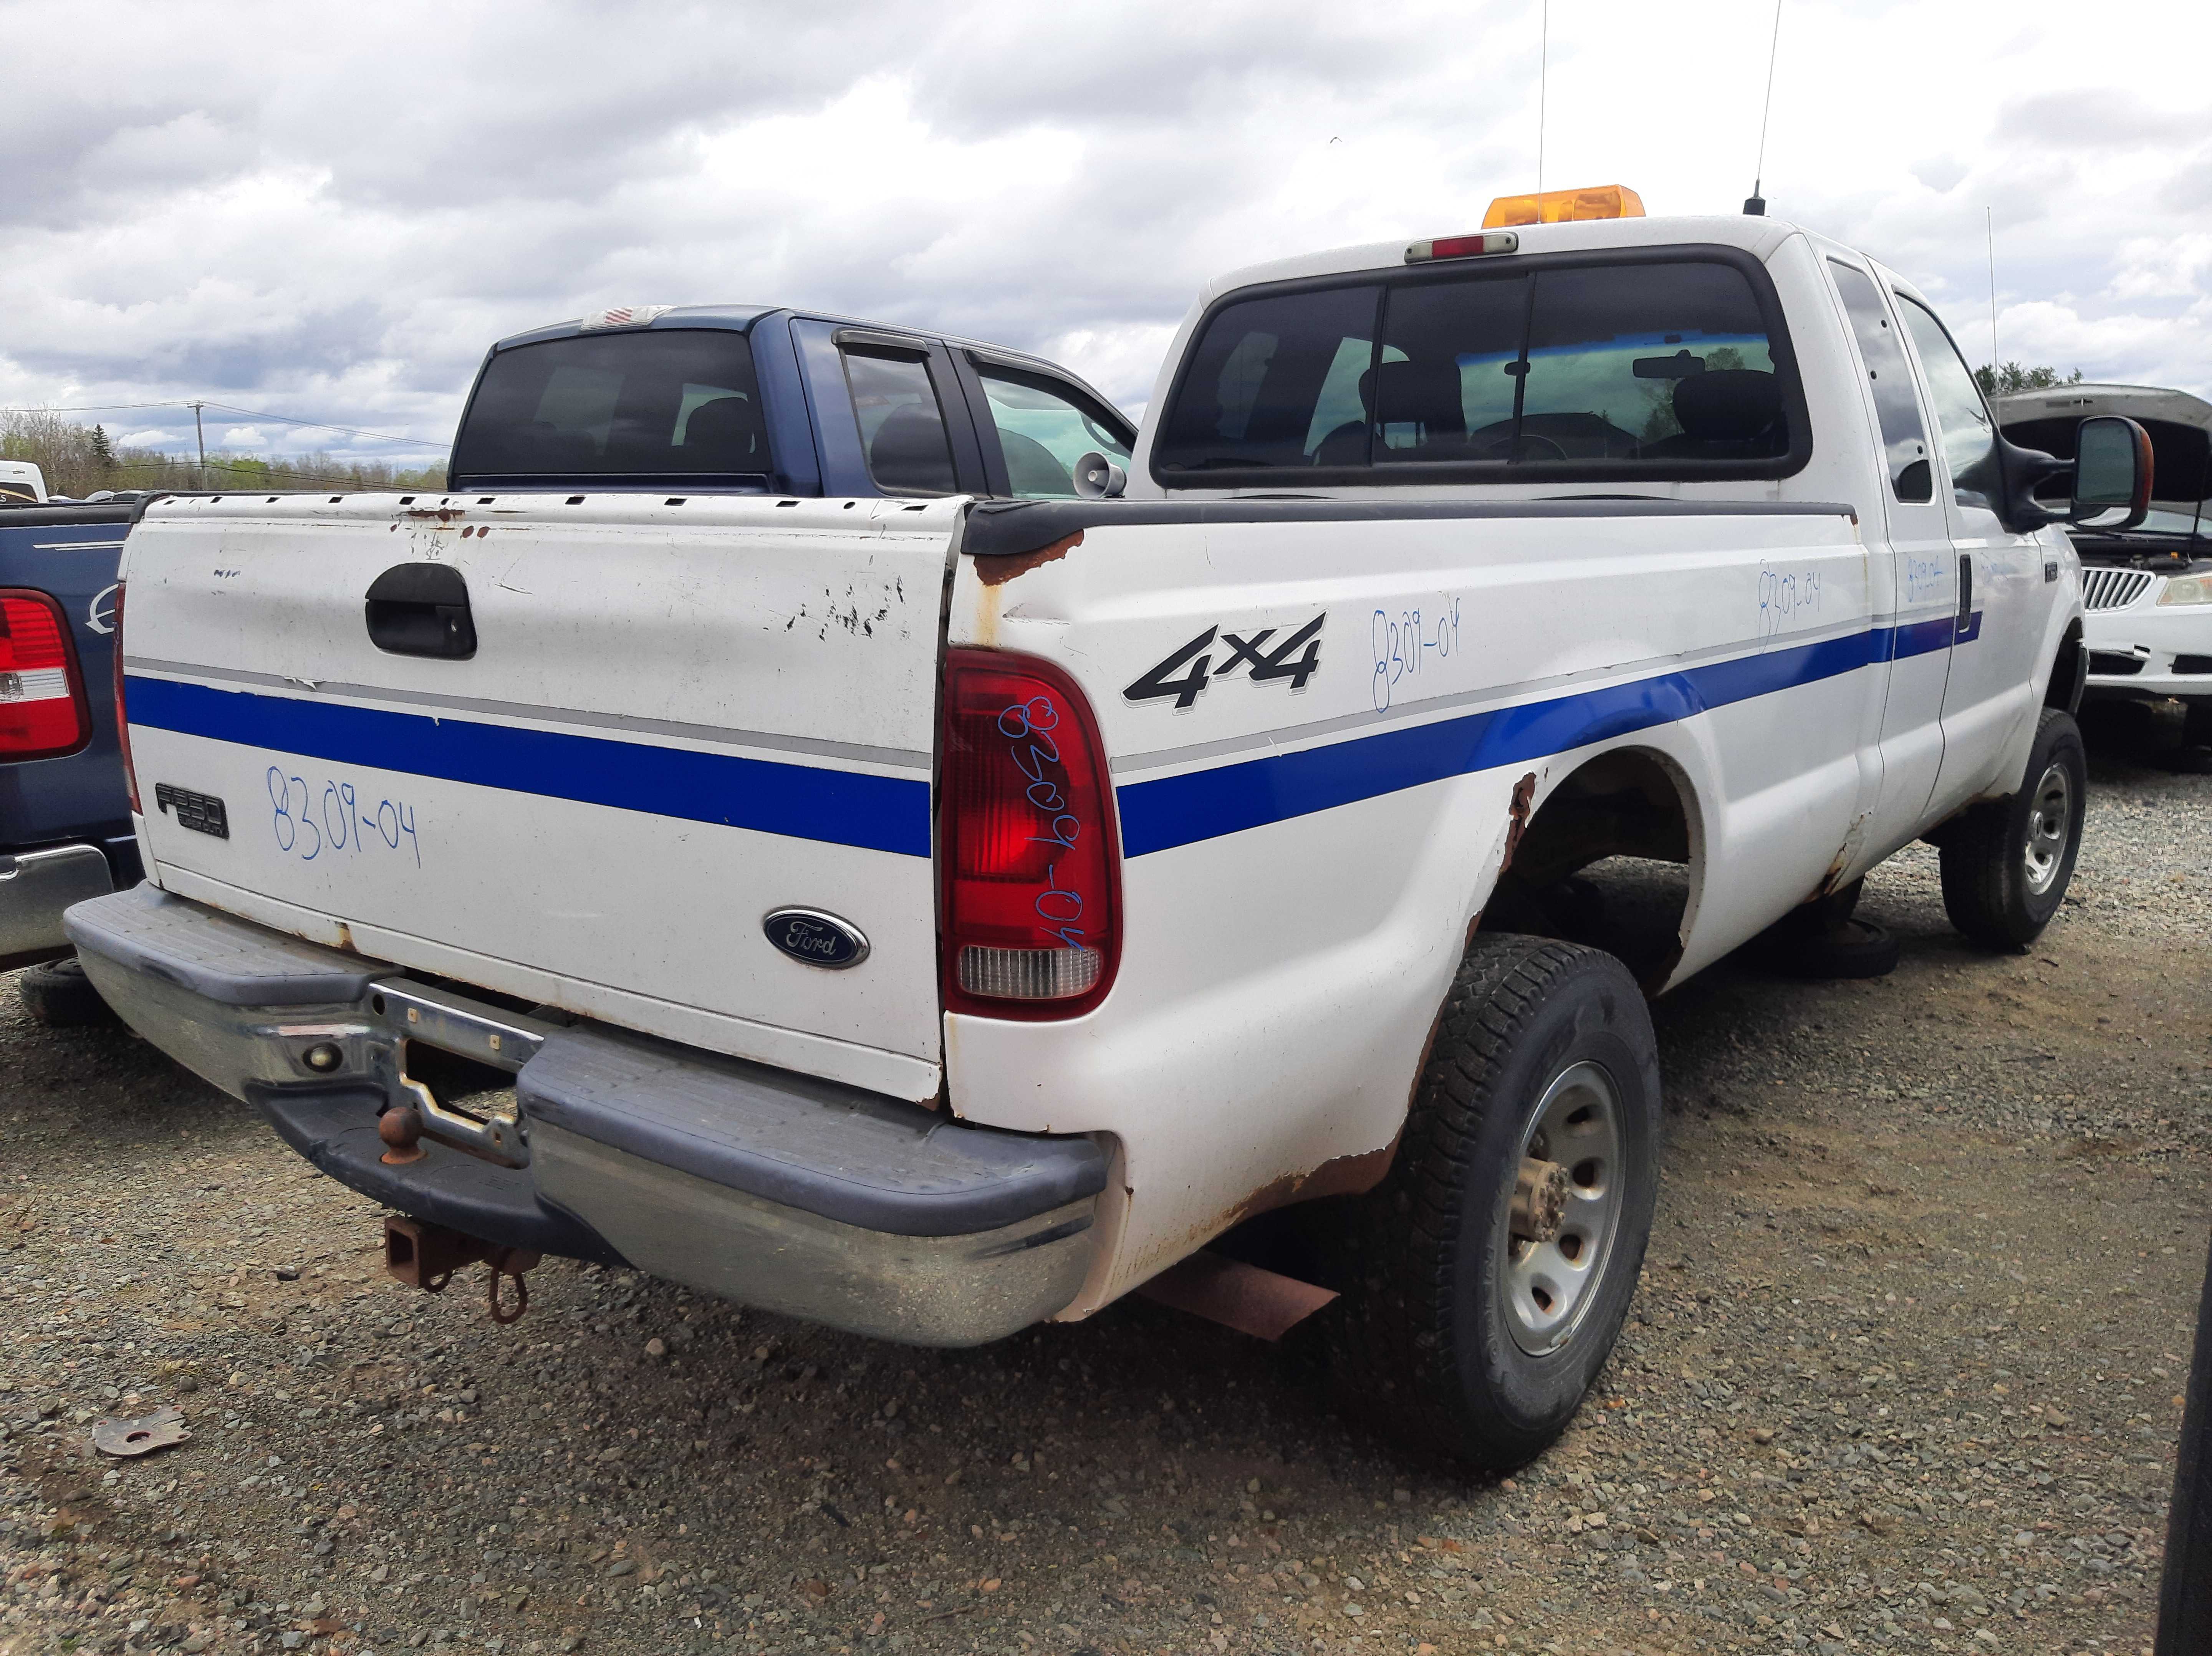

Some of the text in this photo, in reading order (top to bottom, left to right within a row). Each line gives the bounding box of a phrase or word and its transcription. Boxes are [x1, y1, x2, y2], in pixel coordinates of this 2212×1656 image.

[1372, 598, 1460, 713] 8309-04
[267, 766, 421, 869] 8309-04
[998, 696, 1085, 951] 8309-04
[786, 921, 836, 955] Ford
